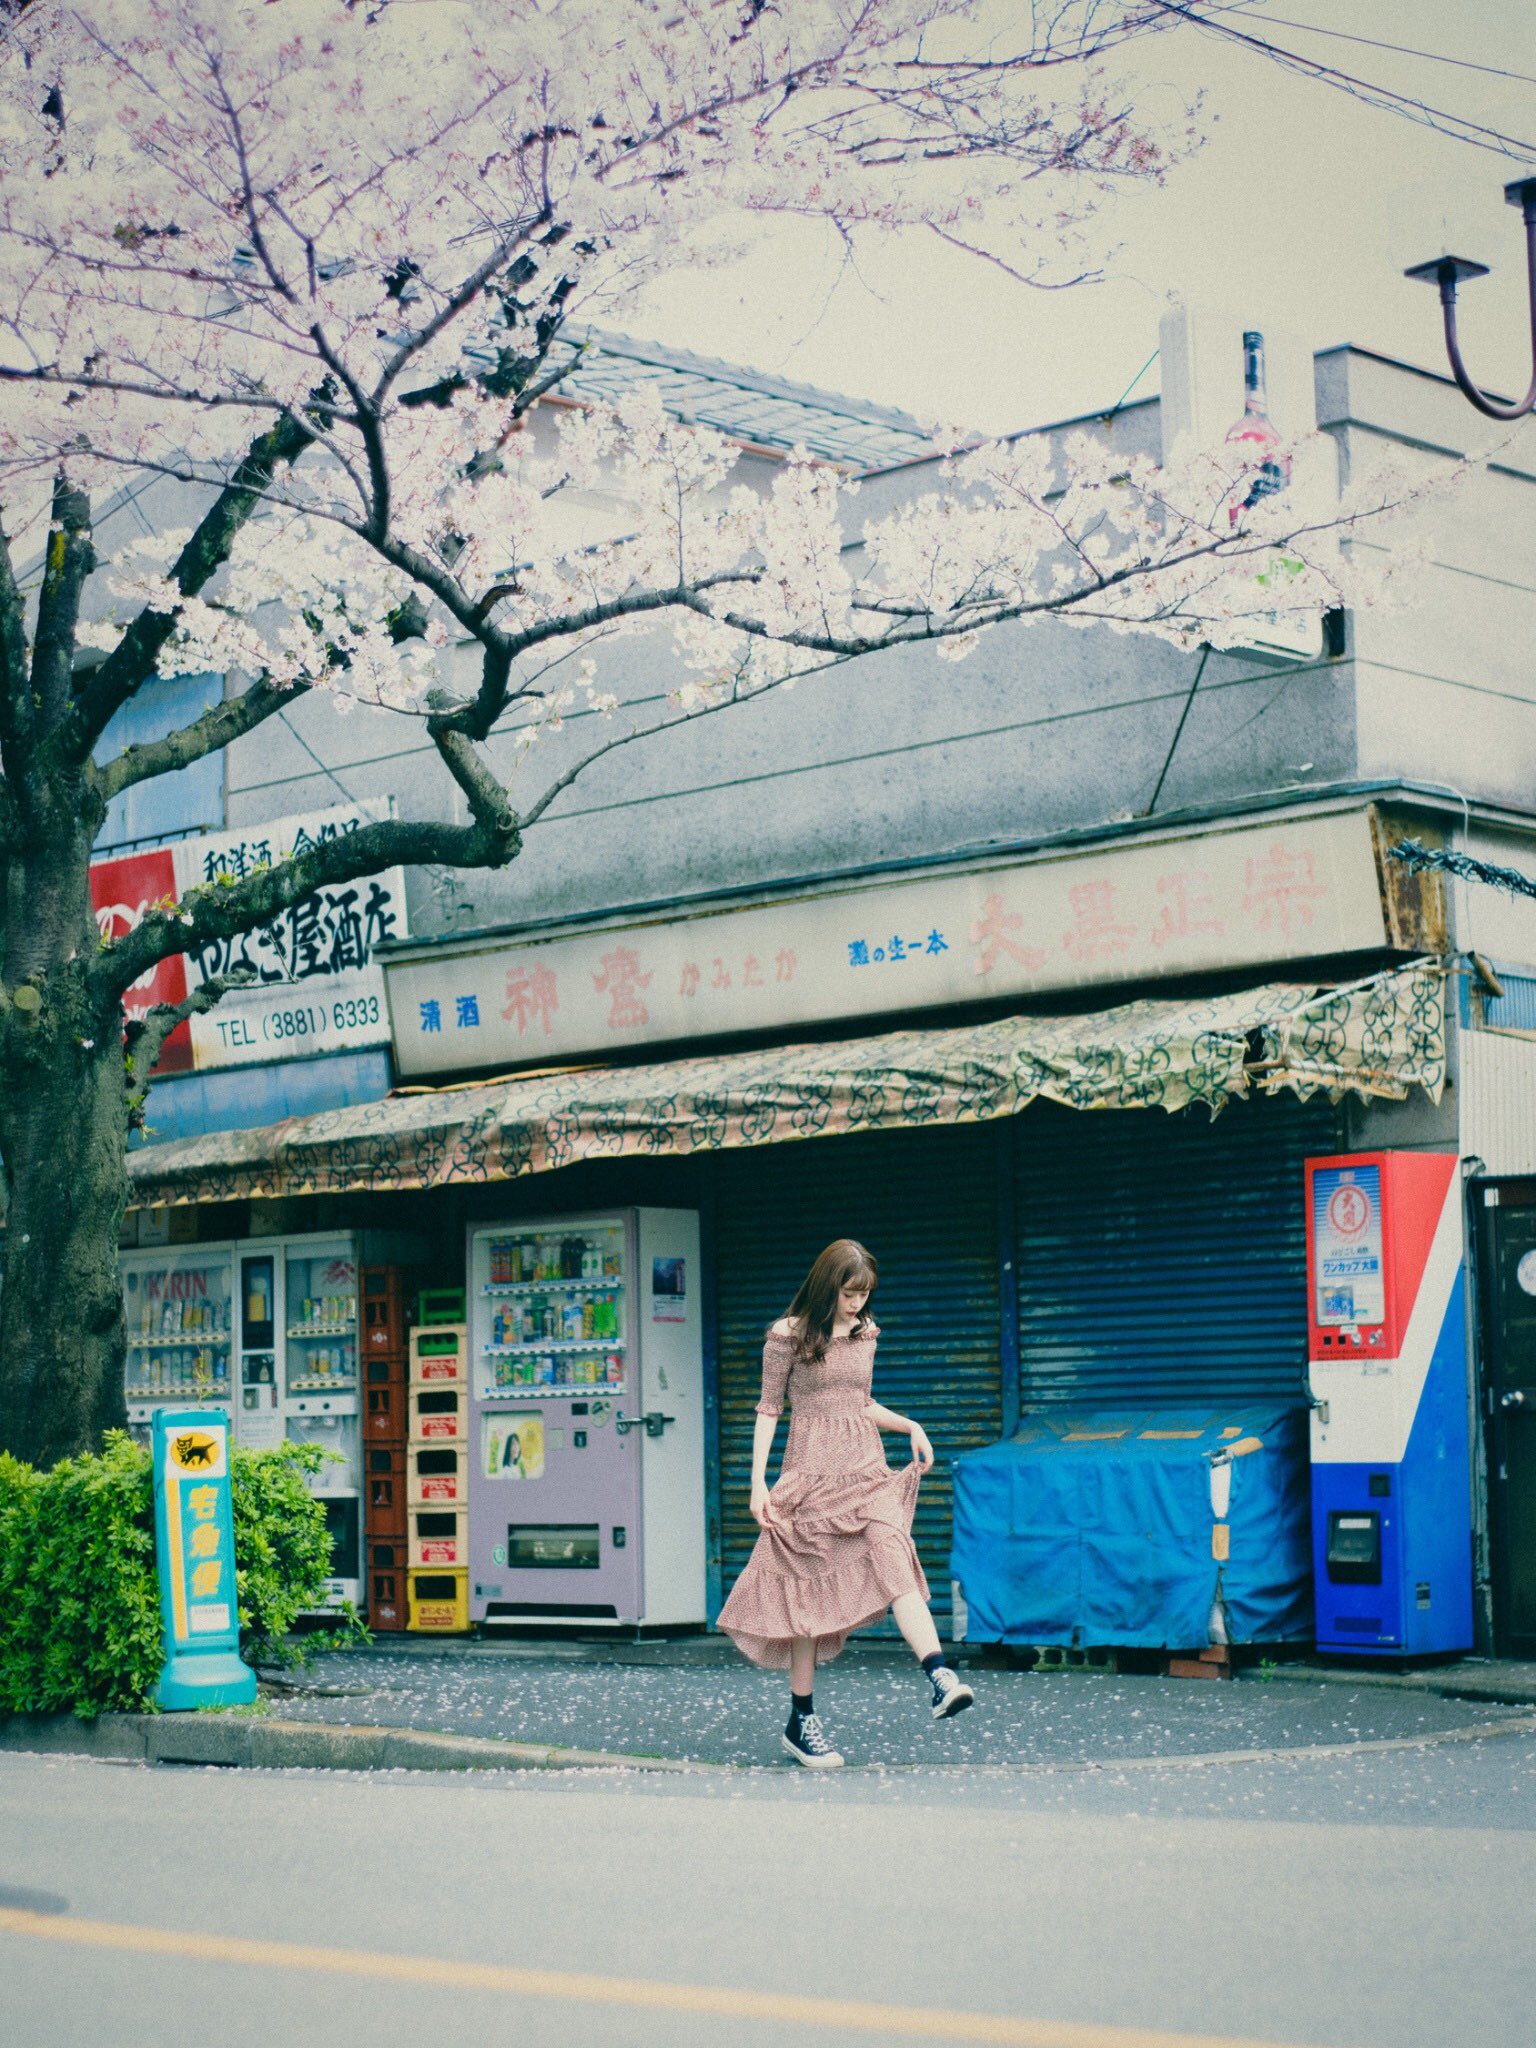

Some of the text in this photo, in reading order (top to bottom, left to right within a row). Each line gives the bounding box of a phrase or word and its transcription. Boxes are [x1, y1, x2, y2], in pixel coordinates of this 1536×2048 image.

[216, 995, 379, 1048] TEL (3881) 6333
[419, 994, 481, 1033] 清酒
[148, 1268, 208, 1300] KIRIN
[188, 1483, 222, 1597] 宅急便
